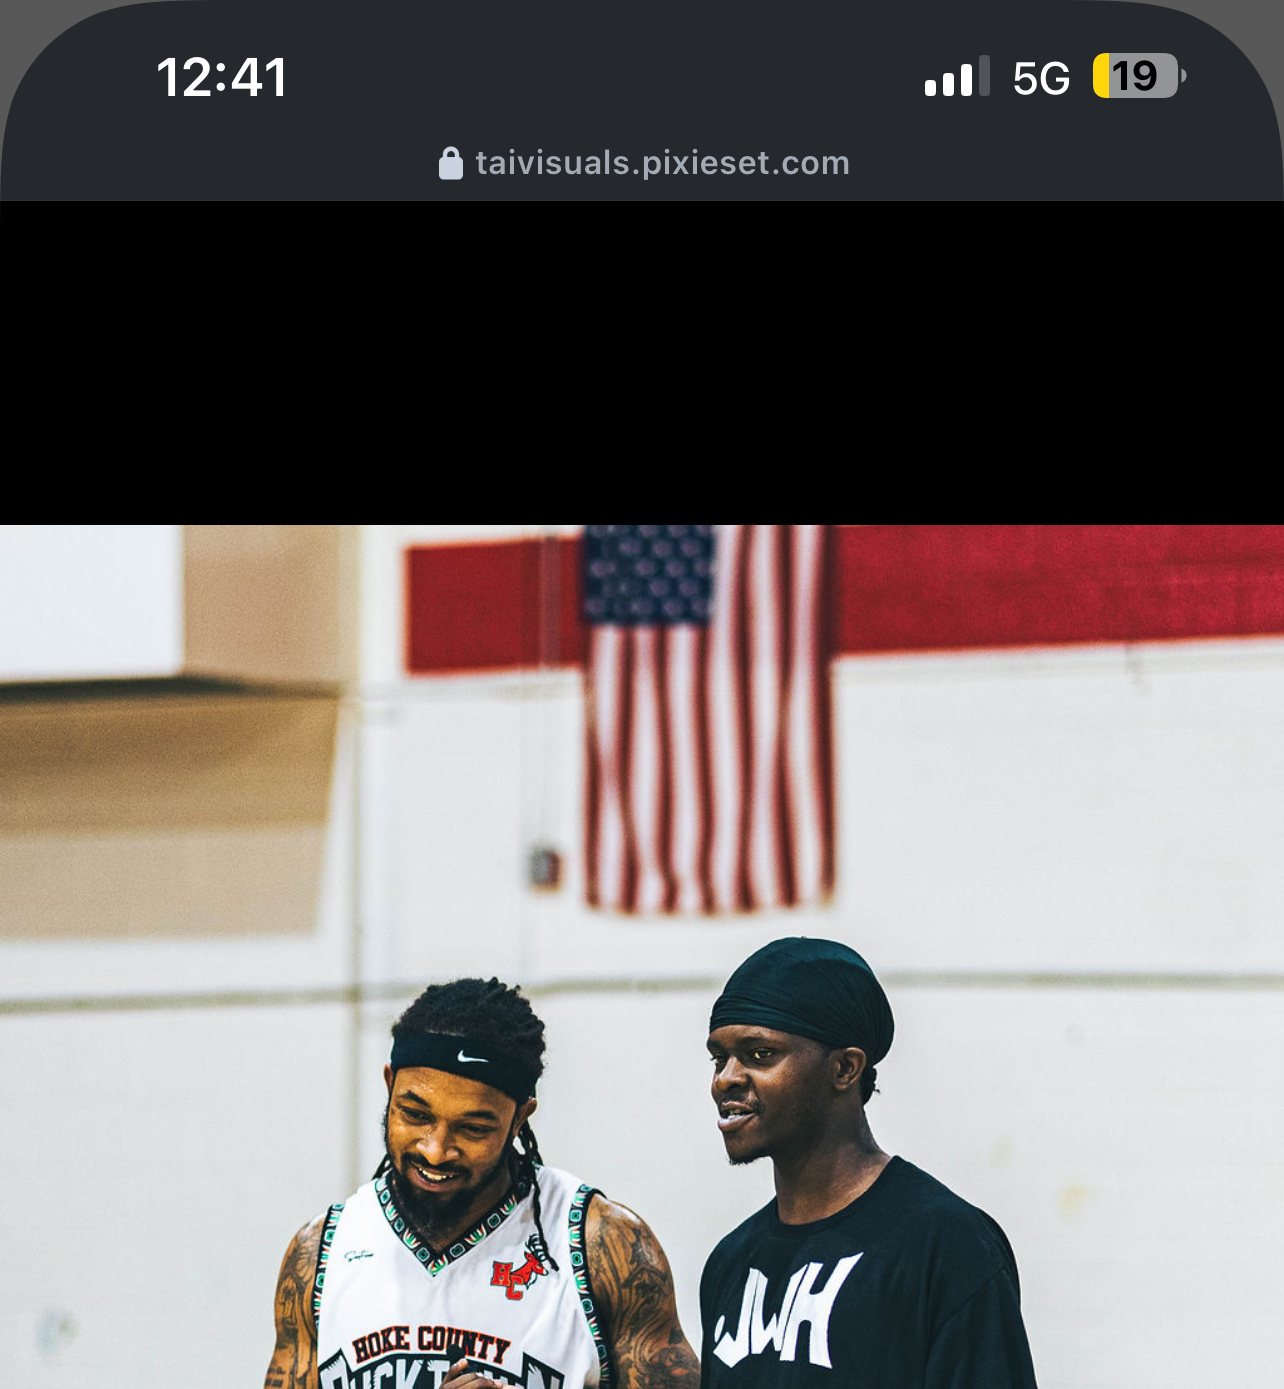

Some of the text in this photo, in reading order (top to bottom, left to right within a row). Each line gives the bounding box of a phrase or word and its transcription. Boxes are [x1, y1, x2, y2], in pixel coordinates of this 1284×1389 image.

[351, 1326, 511, 1365] HOKE COUNTY
[713, 1252, 864, 1369] JWH
